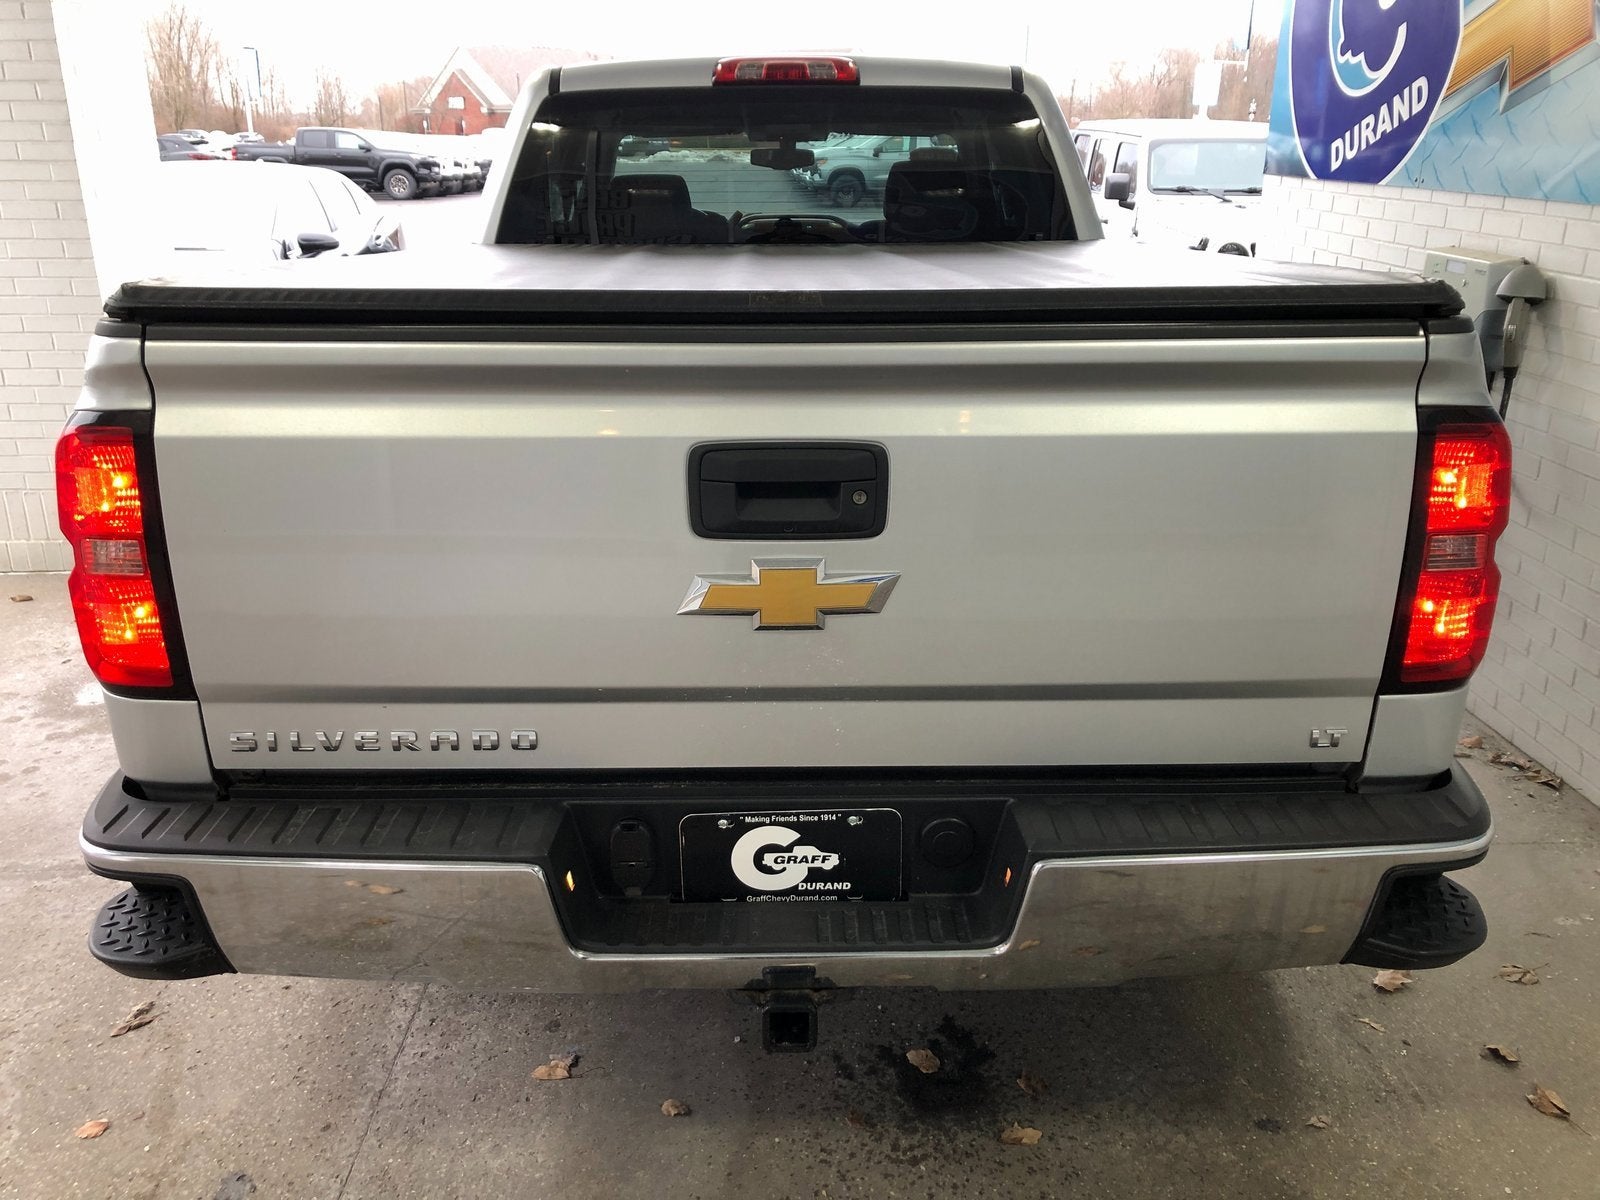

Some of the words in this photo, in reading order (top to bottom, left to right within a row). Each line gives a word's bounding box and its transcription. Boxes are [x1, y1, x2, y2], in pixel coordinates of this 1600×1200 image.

[1330, 75, 1429, 173] DURAND
[229, 729, 539, 752] SILVERADO
[1309, 728, 1348, 748] LT
[745, 815, 770, 824] Making
[771, 814, 798, 823] Friends
[799, 814, 819, 822] Since
[820, 813, 837, 821] 1914
[773, 855, 832, 865] GRAFF
[798, 882, 852, 890] DURAND
[746, 894, 838, 903] GraffChevyDurand.com
